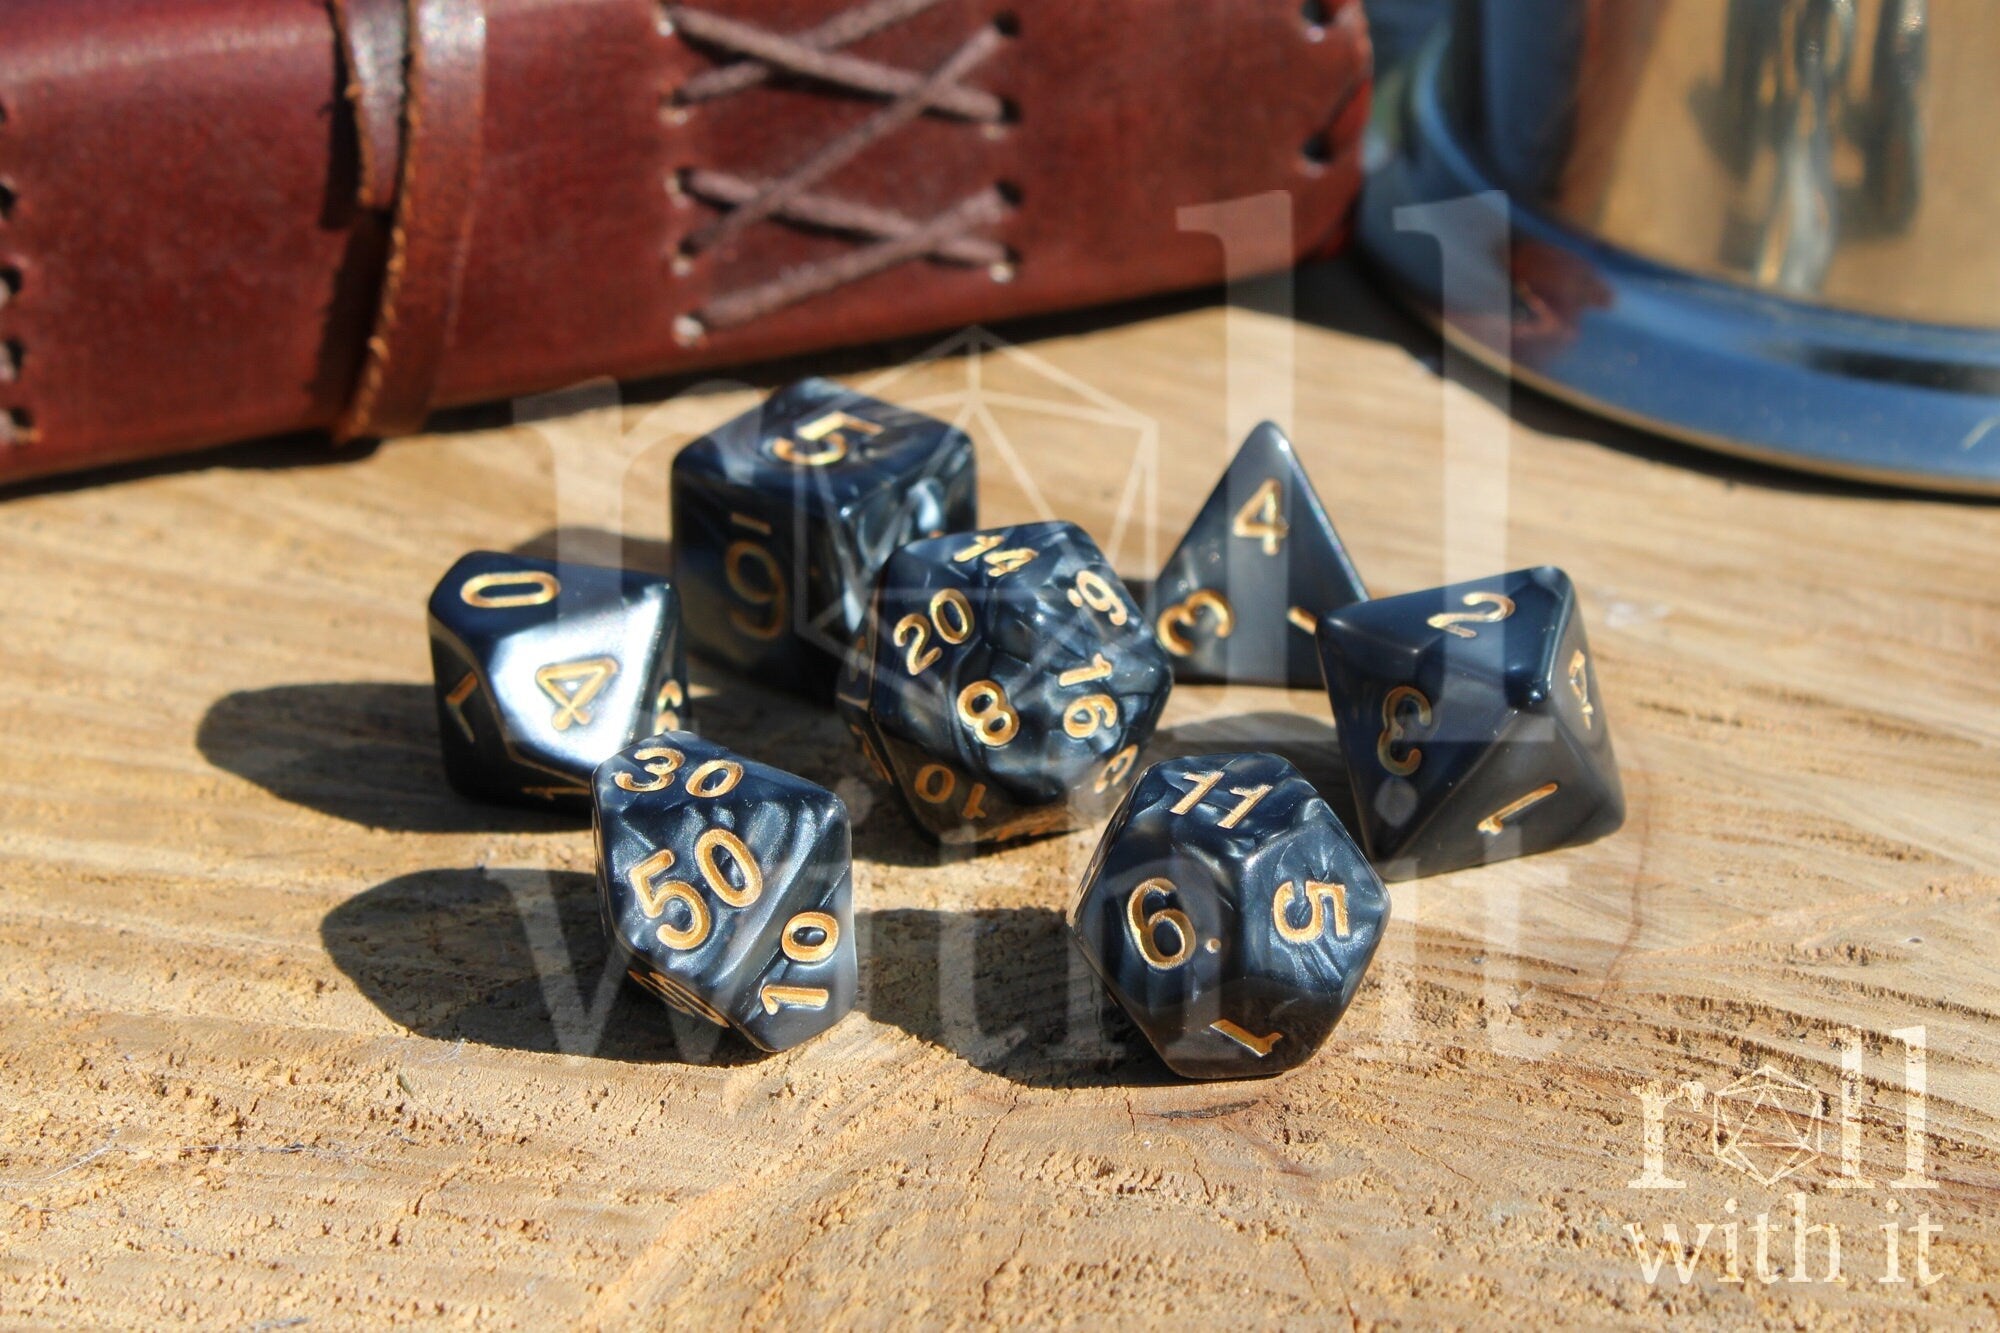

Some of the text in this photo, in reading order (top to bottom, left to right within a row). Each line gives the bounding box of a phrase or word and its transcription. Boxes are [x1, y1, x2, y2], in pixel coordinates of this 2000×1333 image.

[773, 410, 885, 465] 5
[1234, 478, 1289, 556] 4
[954, 535, 1039, 577] 14
[461, 571, 561, 608] 0
[1427, 592, 1515, 638] 2
[893, 588, 975, 675] 20
[1157, 589, 1235, 657] 3
[535, 657, 618, 731] 4
[957, 680, 1020, 746] 8
[1059, 653, 1118, 739] 16
[1377, 686, 1432, 776] 3
[615, 748, 744, 797] 30
[1170, 770, 1273, 829] 11
[1477, 782, 1558, 835] 1
[629, 828, 763, 950] 50
[1273, 880, 1349, 944] 5
[761, 912, 839, 1015] 10
[1210, 1019, 1283, 1058] 1
